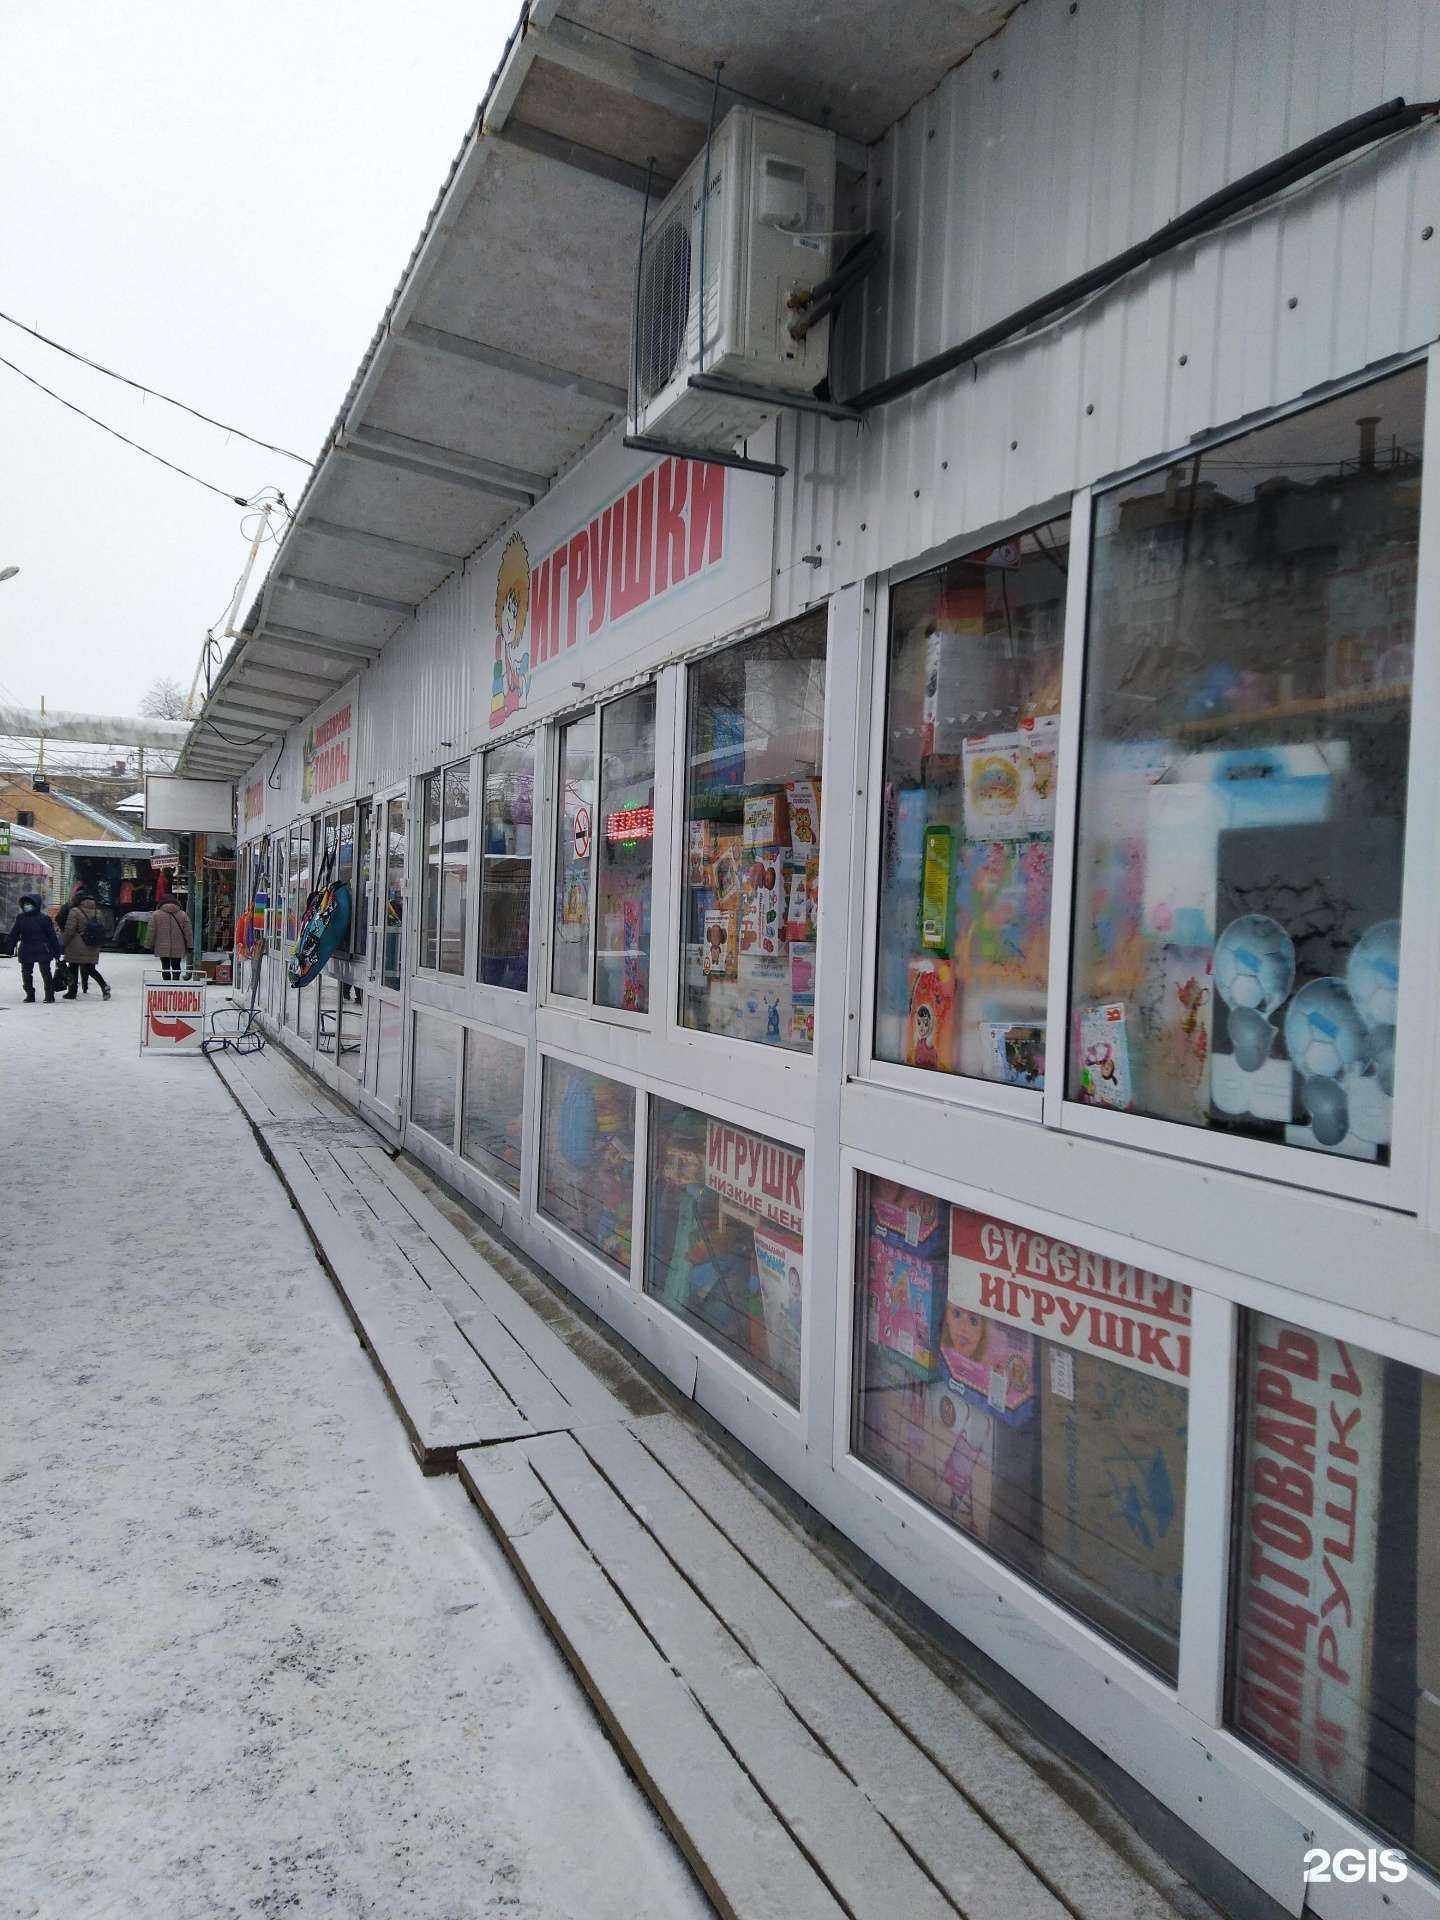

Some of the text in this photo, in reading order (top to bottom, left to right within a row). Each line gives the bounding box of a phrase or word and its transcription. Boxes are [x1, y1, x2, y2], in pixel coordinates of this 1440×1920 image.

[530, 456, 726, 670] ИГРУШКИ
[313, 737, 351, 794] ТОВАРЫ
[147, 990, 201, 1012] КАНЦТОВАРЫ
[708, 1125, 804, 1211] ИГРУШК
[708, 1172, 763, 1214] НИЗКИЕ
